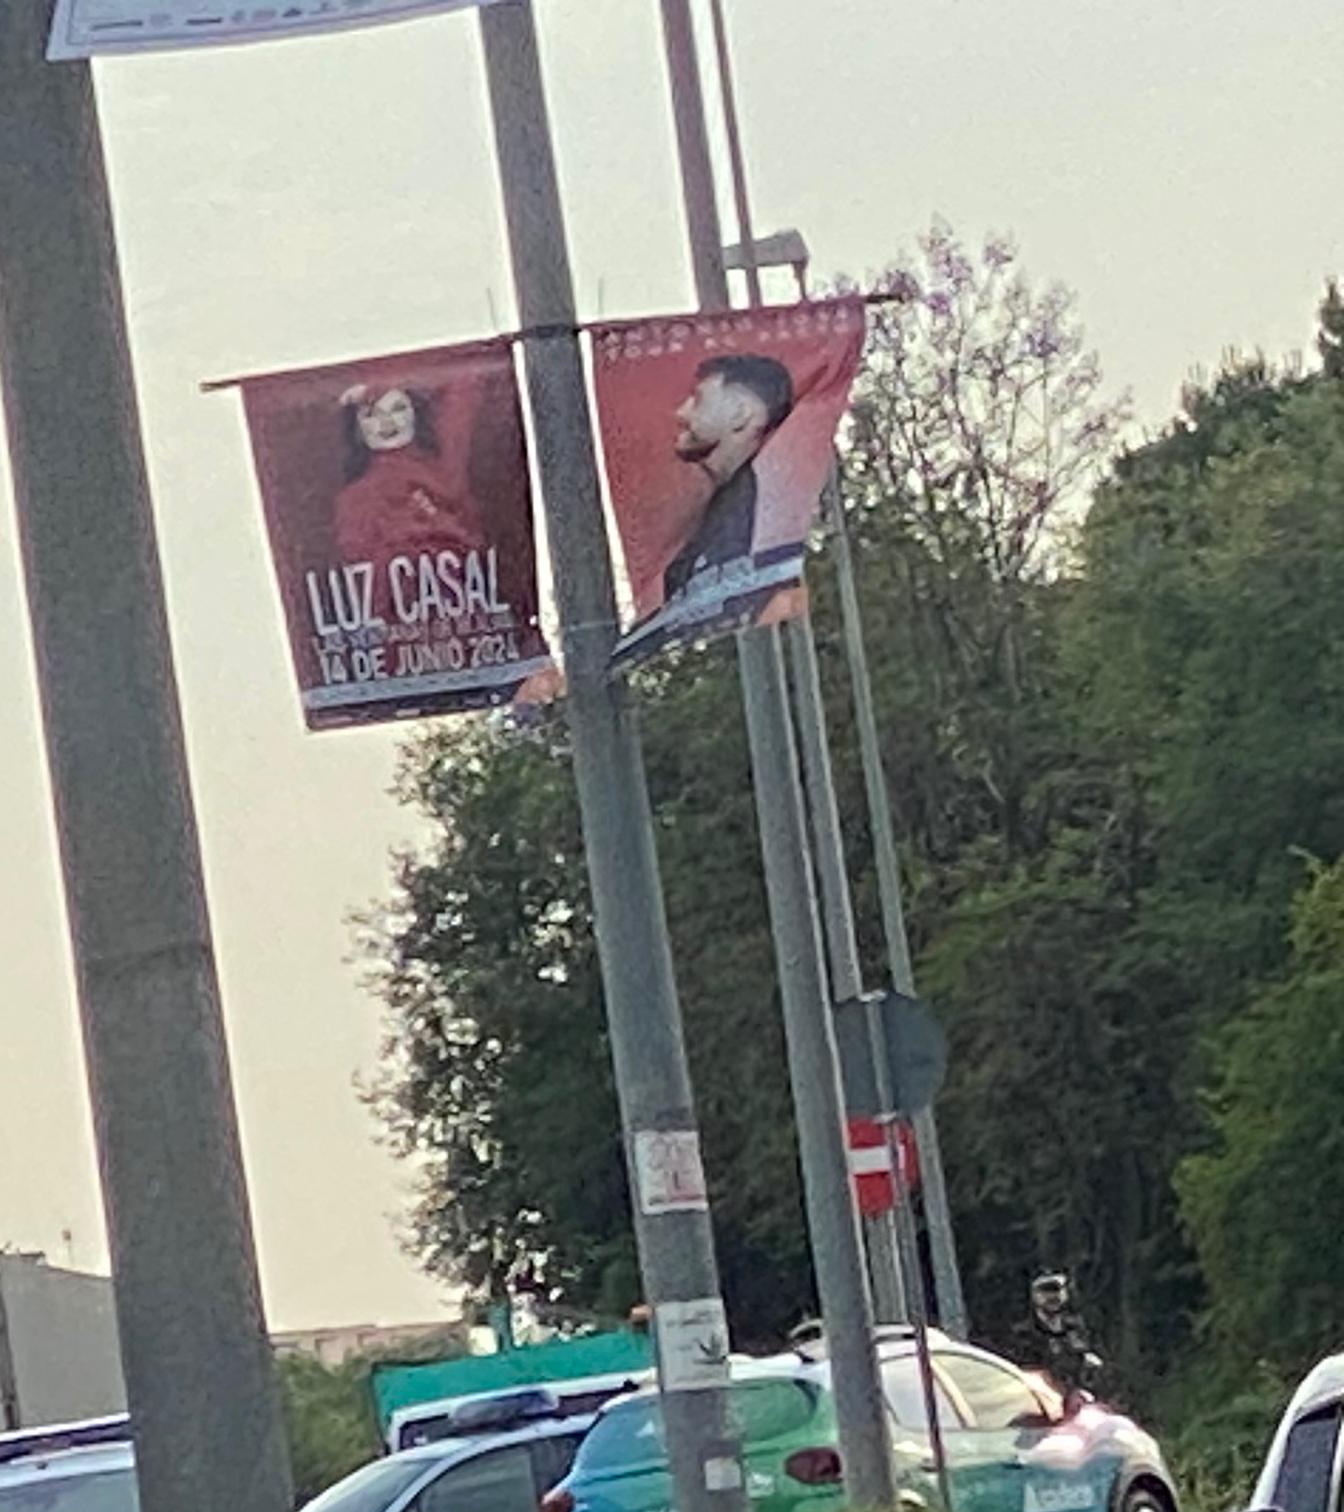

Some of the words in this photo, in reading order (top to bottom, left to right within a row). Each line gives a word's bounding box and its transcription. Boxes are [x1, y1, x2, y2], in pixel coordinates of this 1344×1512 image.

[306, 561, 386, 636] LUZ
[389, 547, 510, 623] CASAL
[319, 652, 347, 685] 14
[352, 648, 389, 680] DE
[395, 638, 463, 677] JUNIO
[468, 632, 520, 668] 2024
